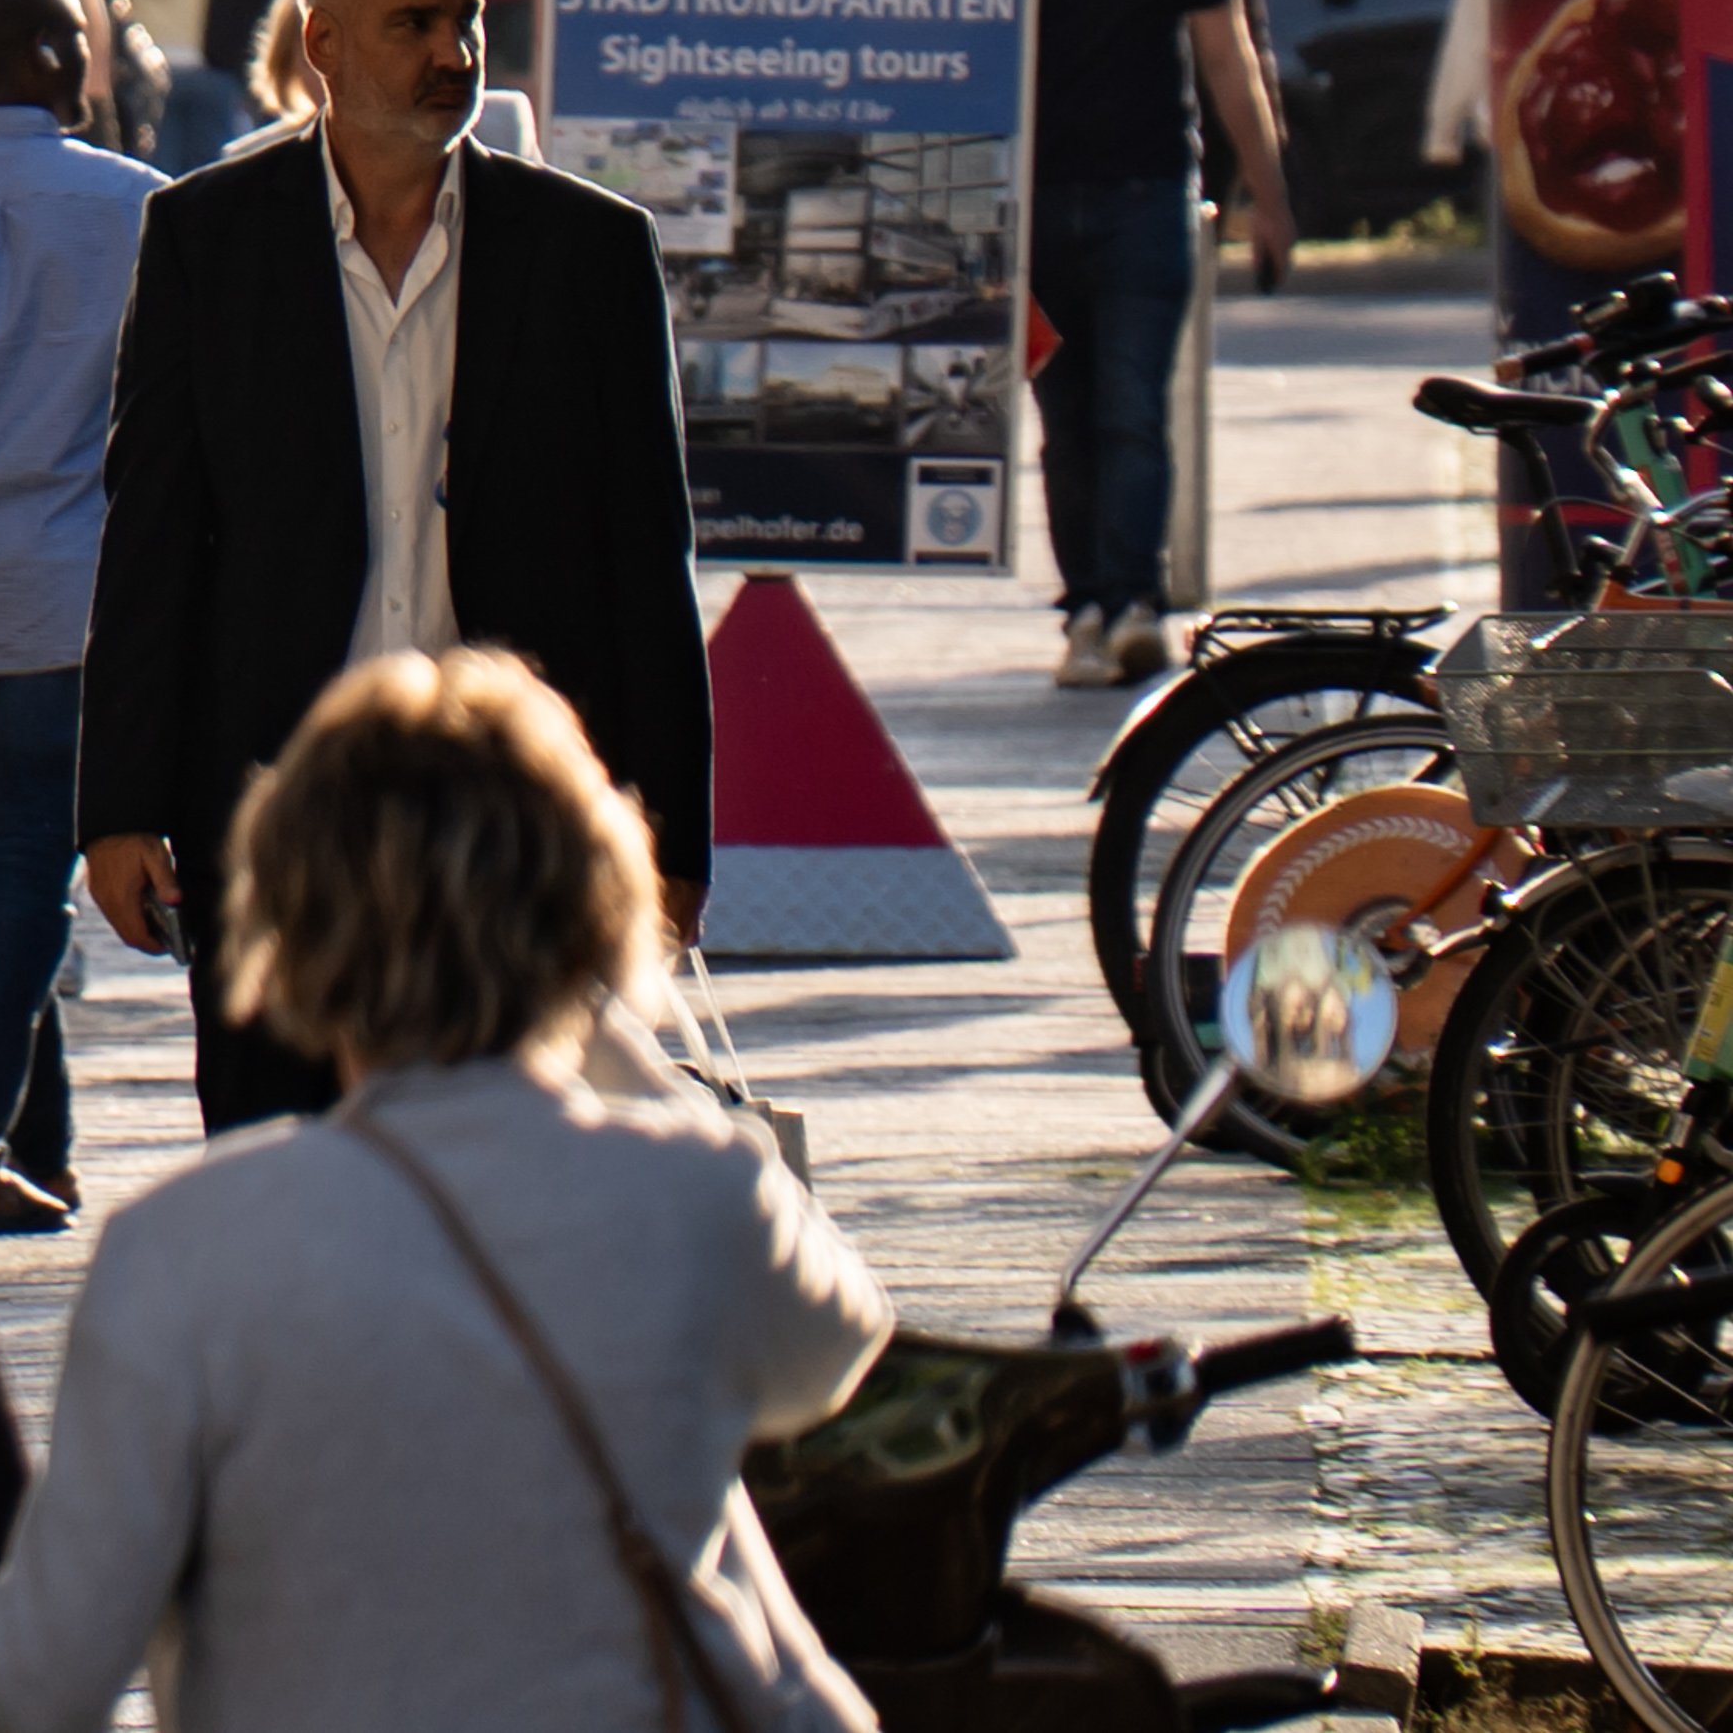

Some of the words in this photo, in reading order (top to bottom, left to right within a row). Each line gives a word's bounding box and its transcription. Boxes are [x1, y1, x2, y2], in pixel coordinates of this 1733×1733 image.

[599, 34, 851, 89] Sightseeing
[860, 44, 971, 81] tours
[695, 515, 865, 545] pelhofer.de
